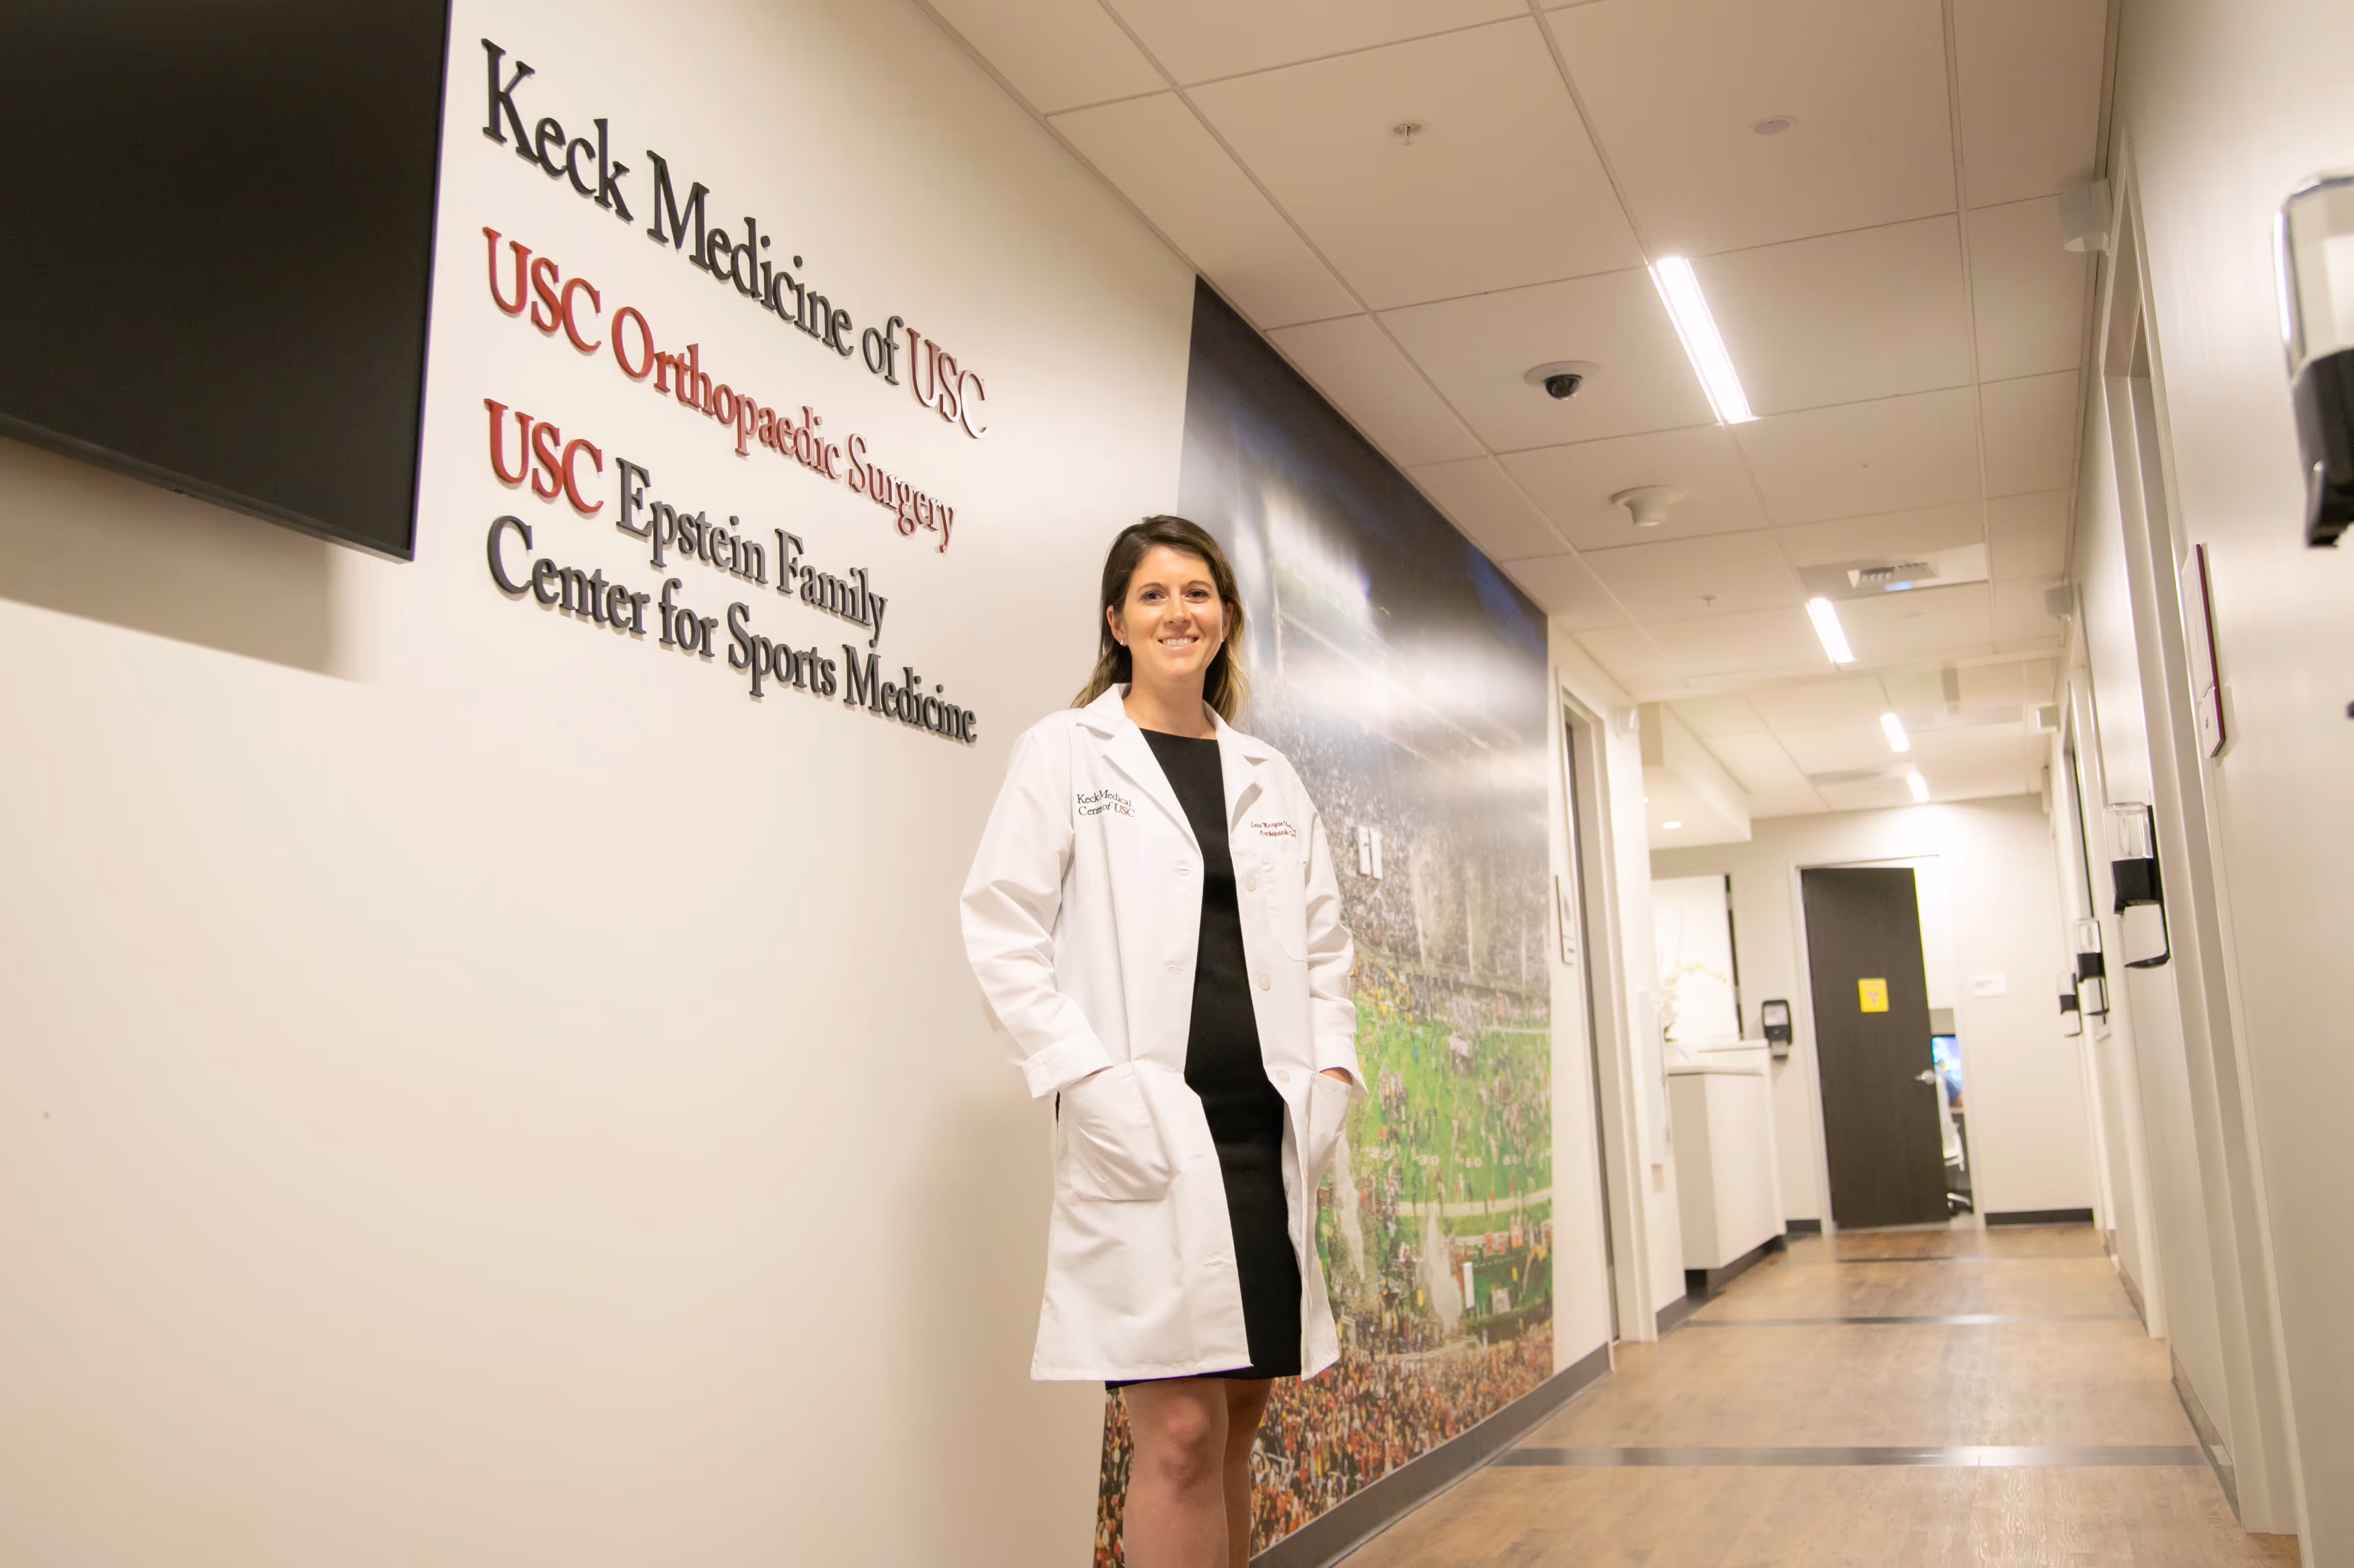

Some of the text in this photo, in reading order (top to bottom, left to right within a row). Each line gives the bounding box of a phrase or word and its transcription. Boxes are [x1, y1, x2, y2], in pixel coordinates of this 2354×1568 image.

[481, 38, 988, 439] Keck Medicine of USC
[483, 227, 954, 553] USC Orthopaedic Surgery
[484, 398, 889, 648] USC Epstein Family
[487, 515, 978, 744] Center for Sports Medicine
[1077, 790, 1131, 807] Keck Medical
[1103, 802, 1113, 810] of
[1114, 803, 1135, 817] USC
